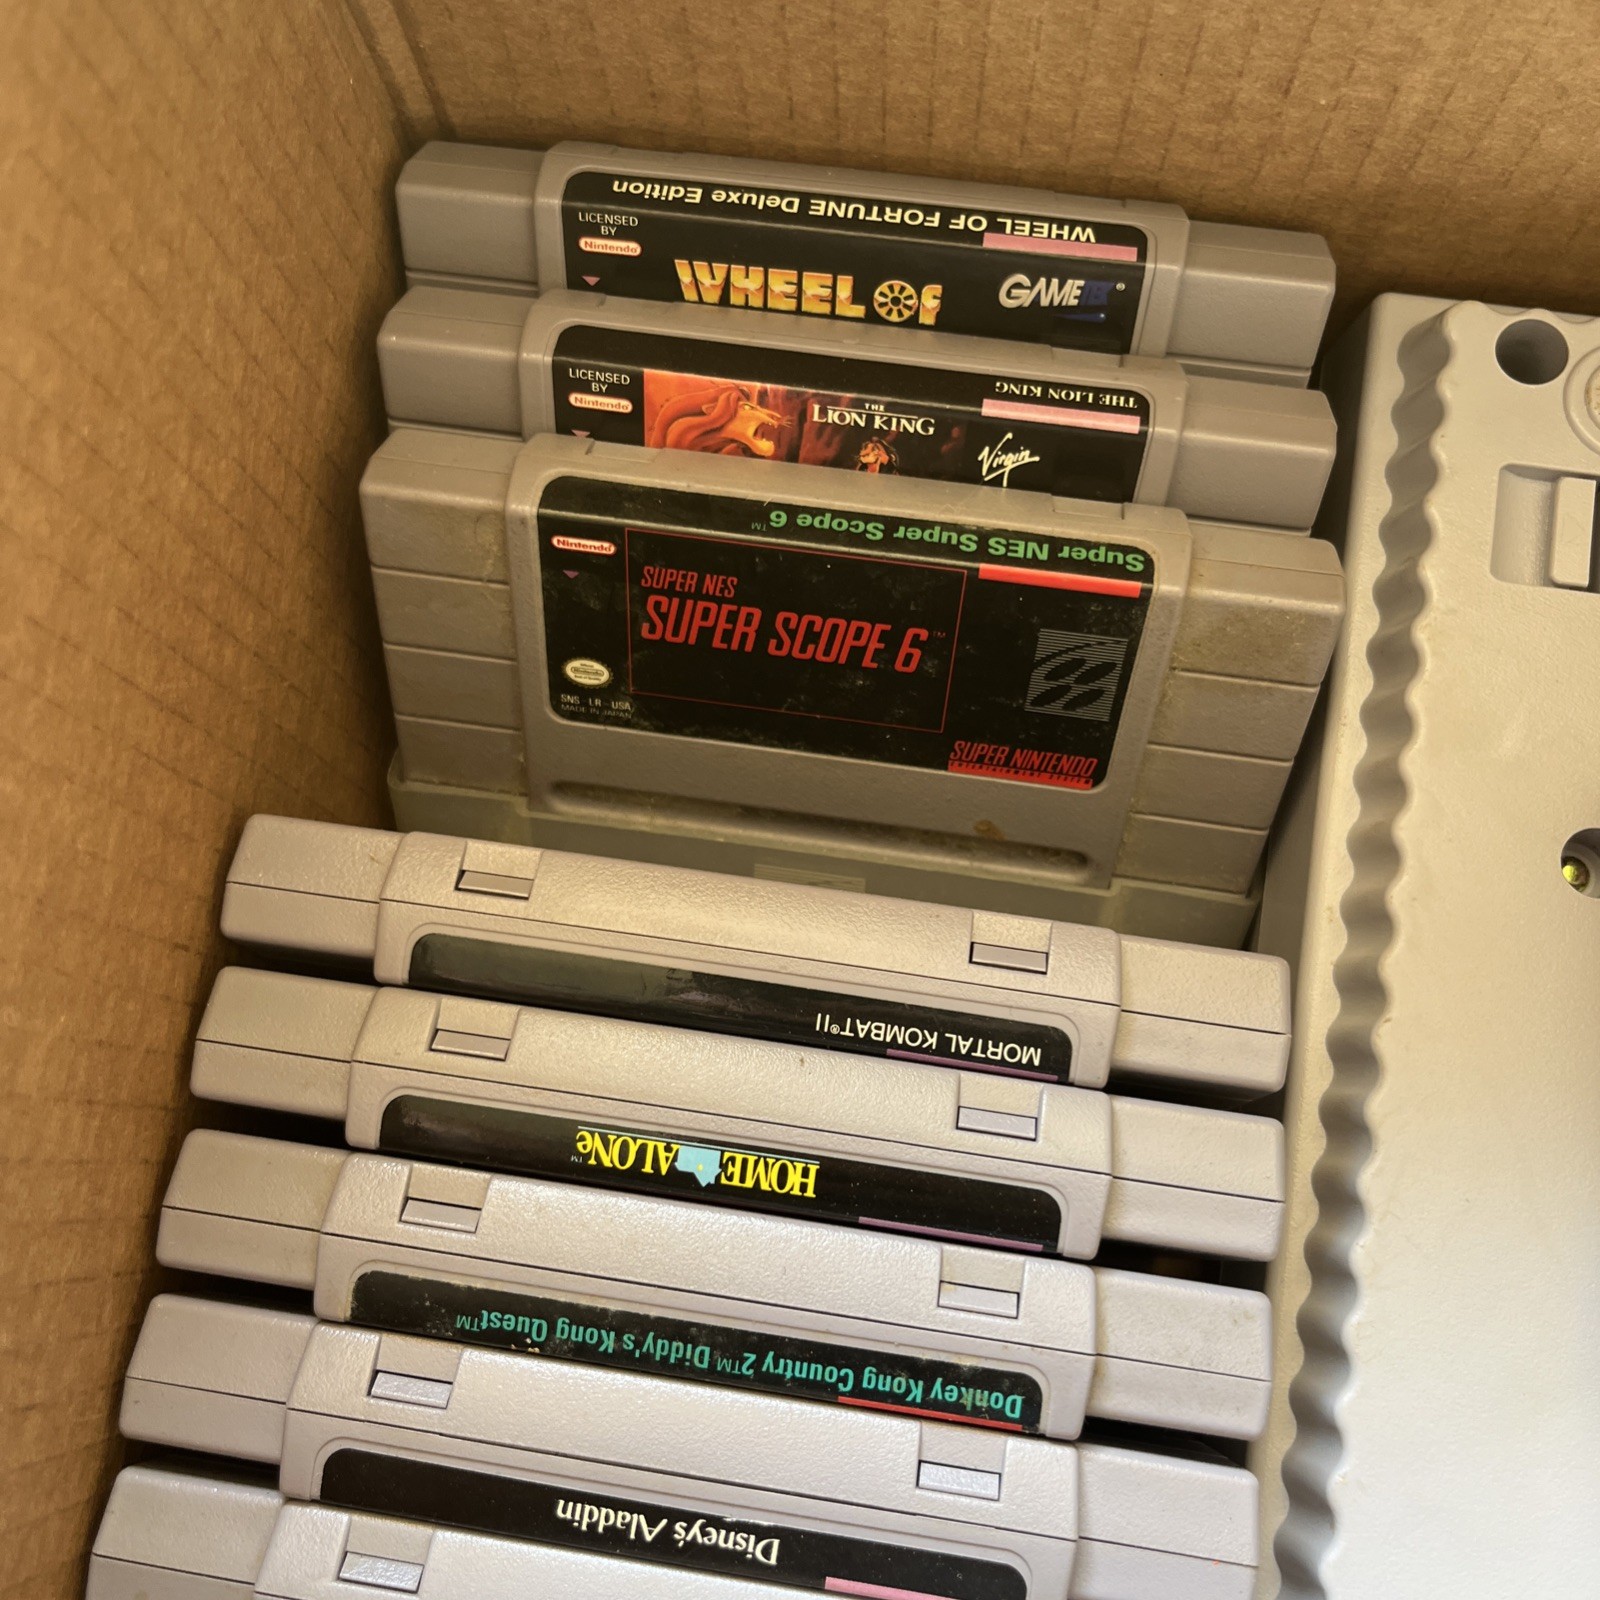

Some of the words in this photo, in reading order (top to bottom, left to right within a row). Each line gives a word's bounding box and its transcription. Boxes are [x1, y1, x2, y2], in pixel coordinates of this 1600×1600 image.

[612, 180, 703, 204] Edition
[711, 191, 800, 214] Deluxe
[578, 212, 638, 227] LICENSED
[808, 199, 941, 227] FORTUNE
[949, 214, 987, 232] OF
[600, 226, 617, 236] BY
[997, 218, 1096, 243] WHEEL
[583, 240, 638, 254] Nintendo
[674, 258, 866, 319] WHEEL
[569, 368, 630, 385] LICENSED
[591, 382, 608, 394] BY
[995, 381, 1042, 397] KING
[574, 396, 630, 411] Nintendo
[864, 402, 885, 412] THE
[1048, 388, 1094, 403] LION
[1099, 393, 1138, 409] THE
[812, 403, 867, 428] LION
[873, 415, 936, 436] KING
[977, 432, 1040, 488] Virgin
[796, 512, 885, 541] Scope
[894, 524, 978, 553] Super
[556, 538, 613, 554] Nintendo
[988, 537, 1049, 562] NES
[1057, 544, 1145, 573] Super
[641, 565, 699, 594] SUPER
[702, 573, 738, 599] NES
[641, 594, 762, 653] SUPER
[768, 610, 891, 670] SCOPE
[950, 740, 1010, 765] SUPER
[1010, 748, 1098, 778] NINTENDO
[945, 1032, 1042, 1067] MORTAL
[720, 1151, 819, 1198] HOME
[556, 1317, 616, 1353] Kong
[622, 1331, 711, 1369] Diddy's
[761, 1351, 855, 1393] Country
[862, 1366, 923, 1403] Kong
[929, 1377, 1023, 1419] Donkey
[556, 1499, 668, 1543] Aladdin
[673, 1518, 781, 1566] Disney's
